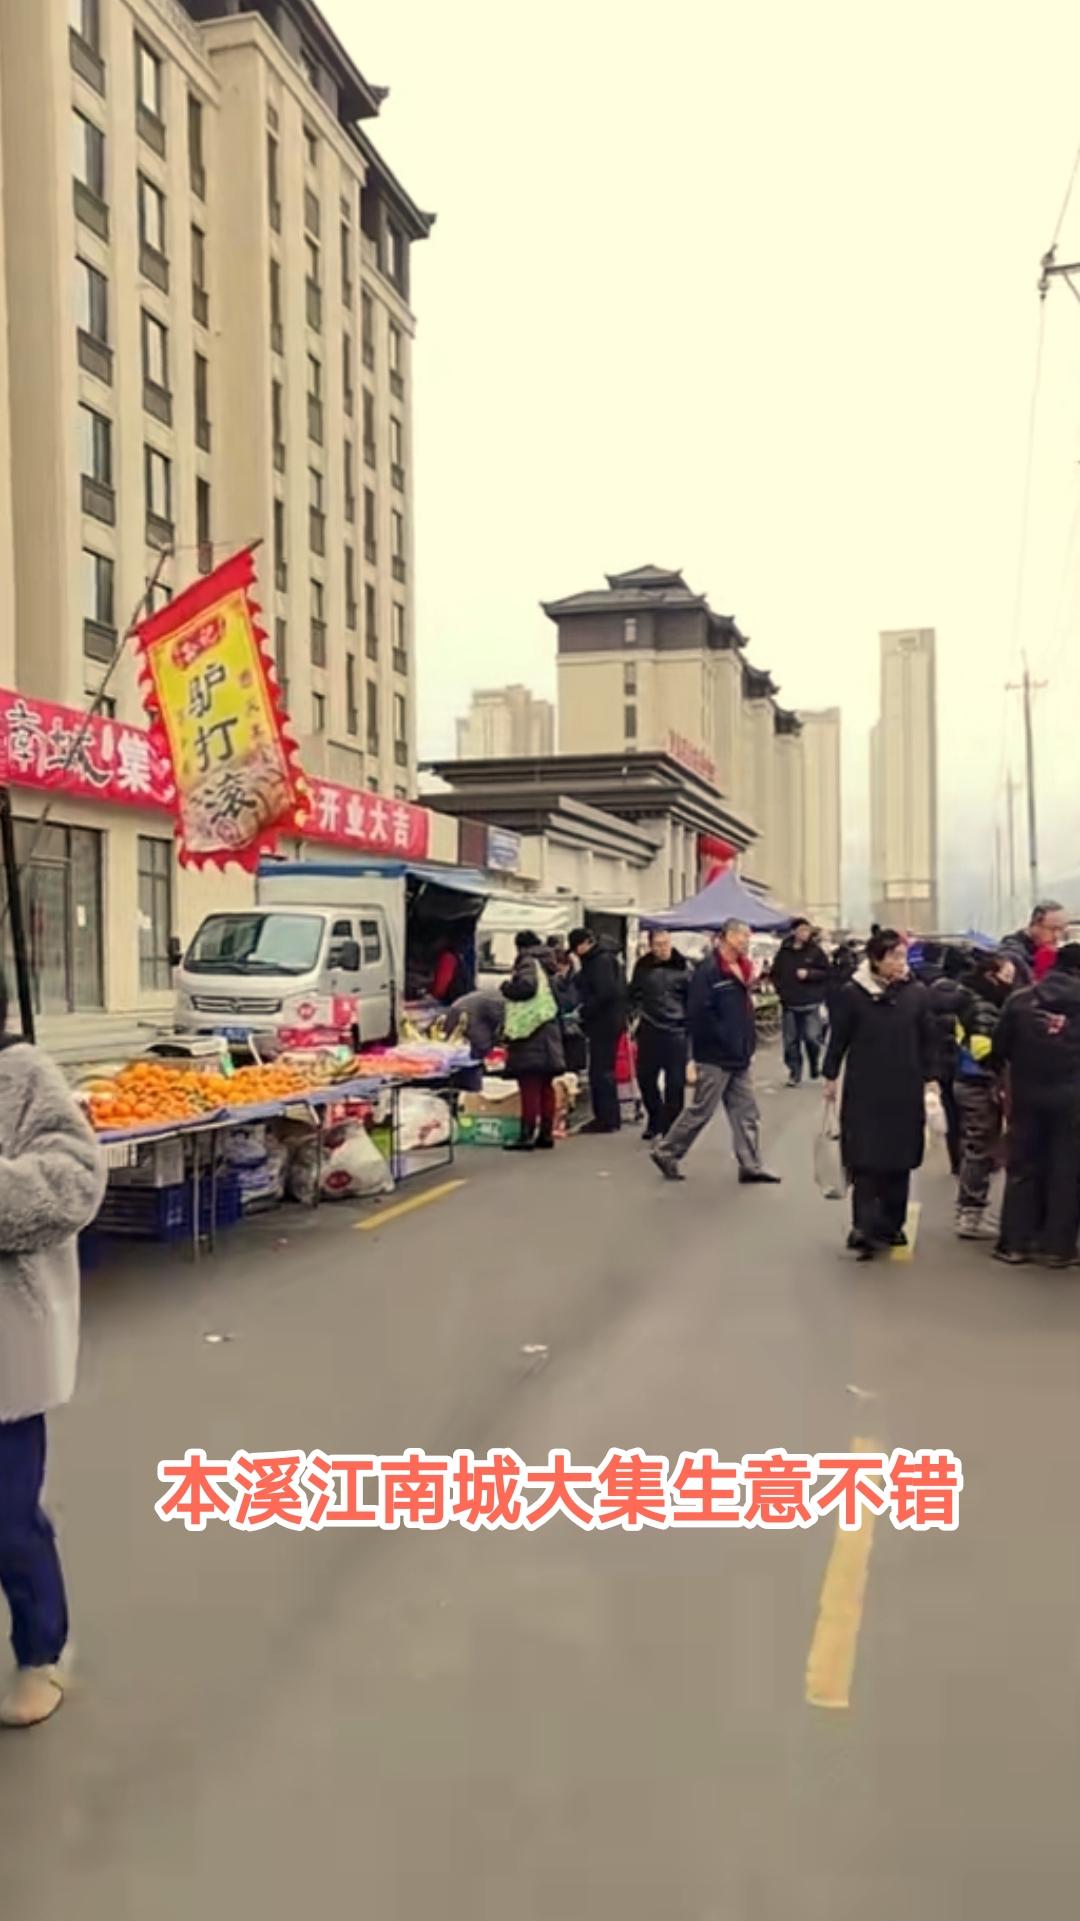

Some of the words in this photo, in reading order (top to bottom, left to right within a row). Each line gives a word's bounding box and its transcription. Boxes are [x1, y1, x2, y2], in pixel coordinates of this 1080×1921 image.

[188, 662, 257, 825] 驴打滚
[318, 785, 410, 849] 开业大吉
